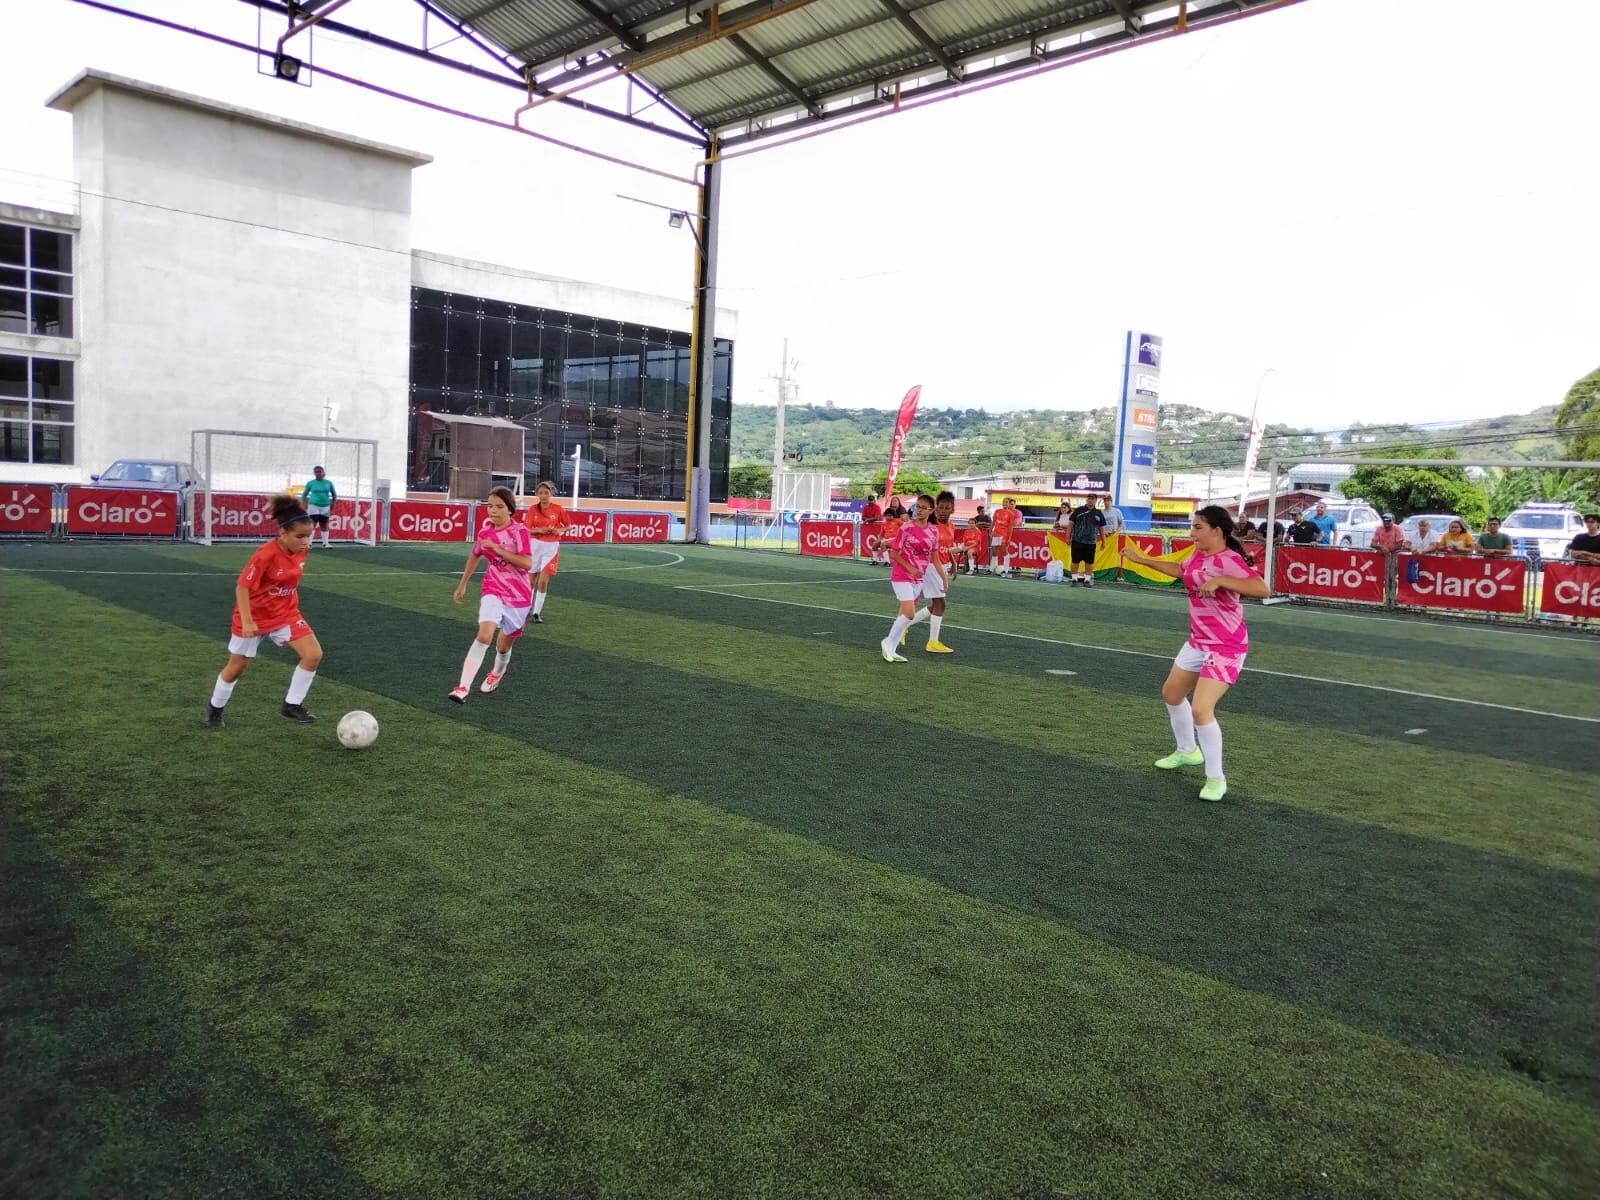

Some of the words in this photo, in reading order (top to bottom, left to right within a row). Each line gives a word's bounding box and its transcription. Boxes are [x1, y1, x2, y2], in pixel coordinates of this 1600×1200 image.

[78, 497, 154, 524] Claro
[399, 509, 454, 533] Claro
[617, 519, 656, 538] Claro
[806, 528, 844, 549] Claro
[1286, 558, 1363, 588] Claro
[1410, 565, 1498, 599] Claro
